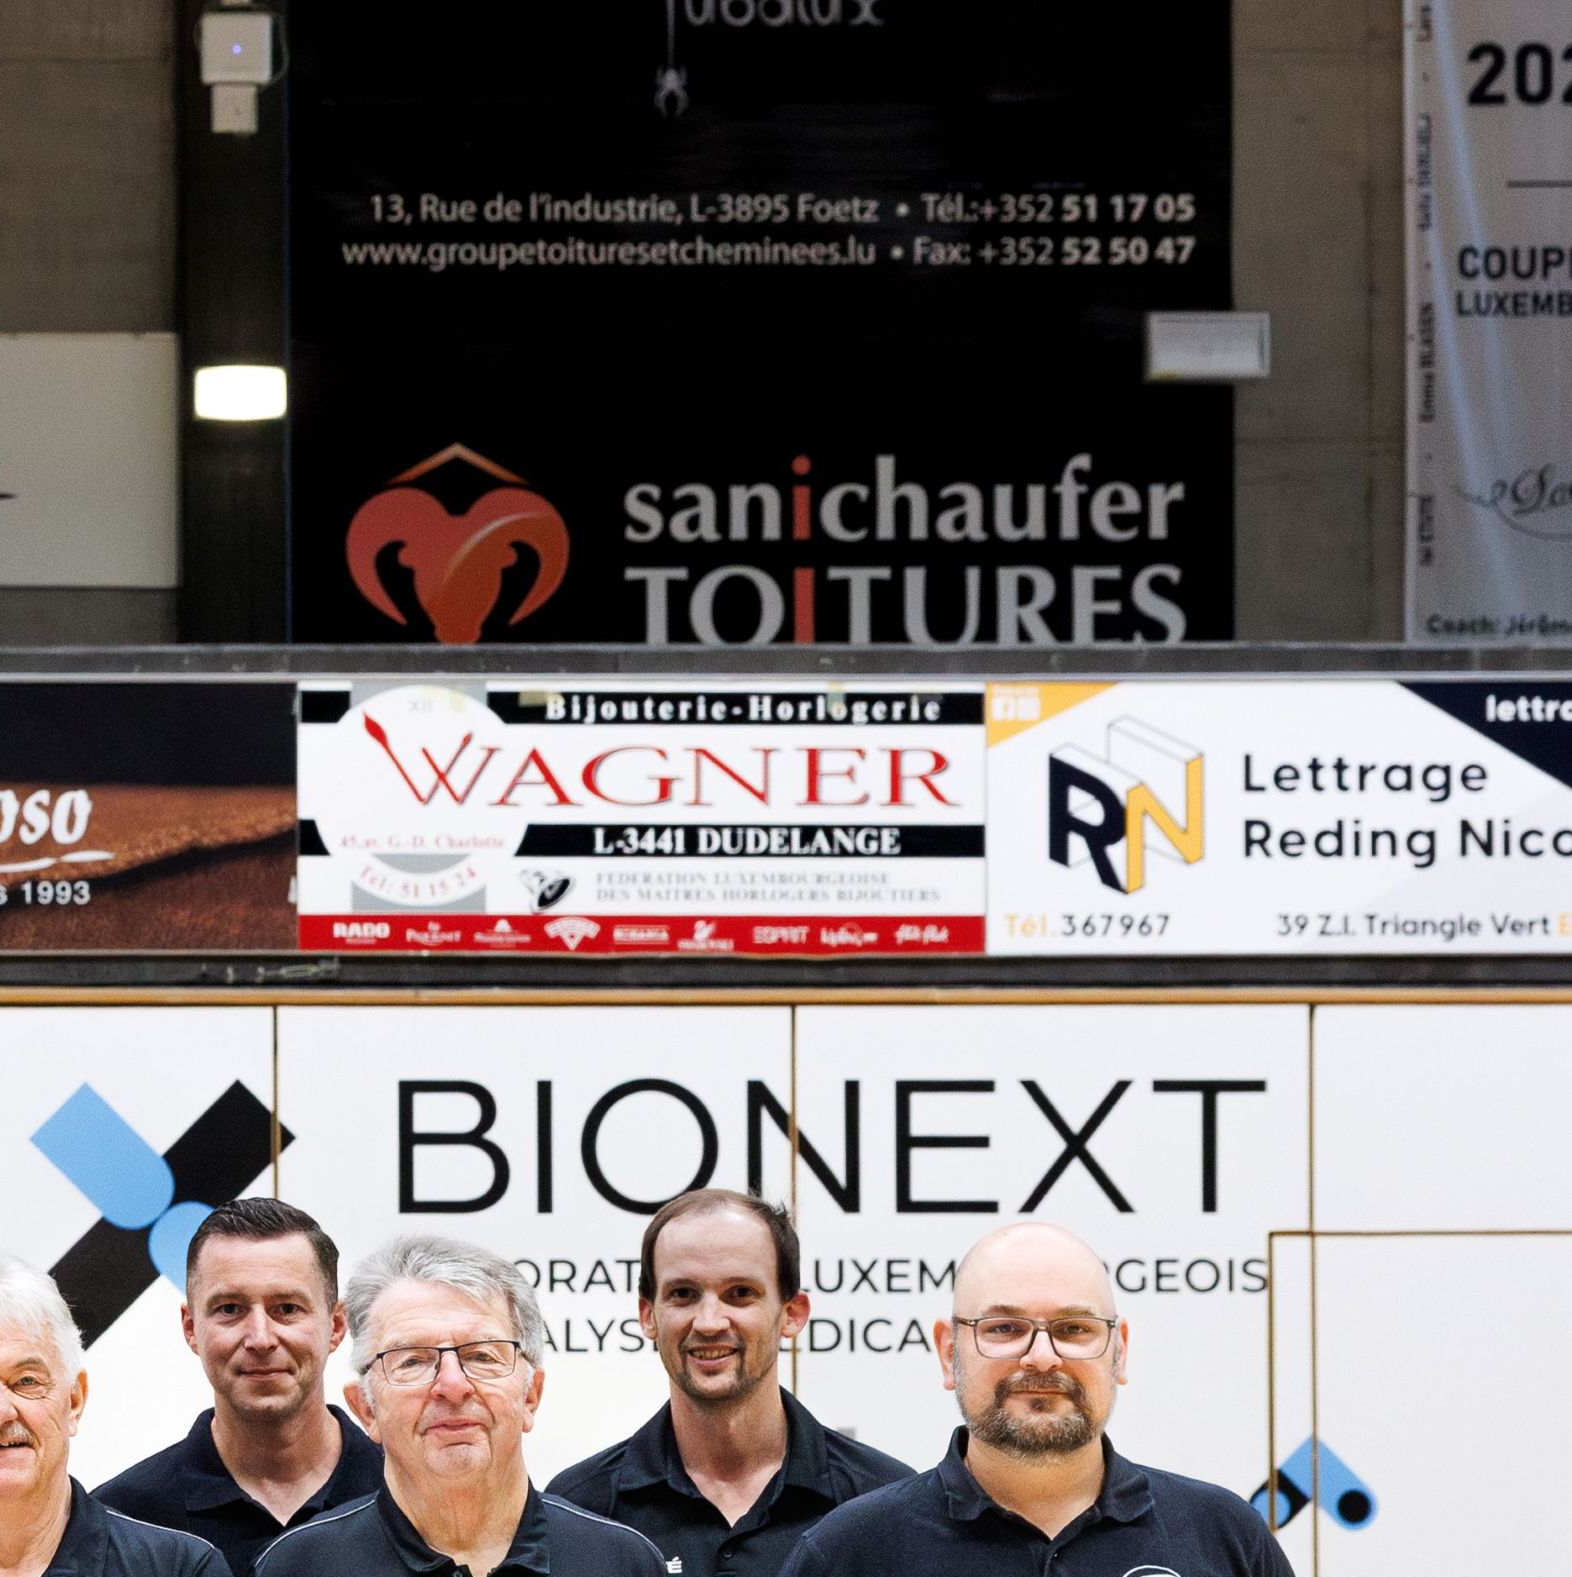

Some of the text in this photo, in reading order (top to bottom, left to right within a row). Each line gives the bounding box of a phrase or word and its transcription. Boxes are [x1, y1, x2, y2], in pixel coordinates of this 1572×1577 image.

[370, 194, 412, 225] 13,
[419, 194, 476, 222] Rue
[484, 193, 522, 222] de
[690, 193, 789, 222] L-3895
[797, 193, 881, 222] Foetz
[1061, 194, 1096, 222] 51
[1110, 194, 1148, 222] 17
[1155, 194, 1195, 222] 05
[341, 234, 1195, 273] www.groupetoituresetcheminees.lu Fax: +352 52 50 47
[1458, 246, 1572, 281] COUP
[624, 453, 1185, 541] sanichaufer
[624, 565, 1187, 644] TOITURES
[546, 693, 942, 725] Bijouterie-Horlogerie
[363, 711, 962, 807] WAGNER
[1244, 753, 1488, 802] Lettrage
[593, 826, 902, 856] L-3441 DUDELANGE
[1244, 819, 1436, 868] Reding
[21, 880, 93, 905] 1993
[1062, 914, 1170, 937] 367967
[1277, 914, 1309, 936] 39
[1365, 912, 1482, 942] Triangle
[1491, 913, 1550, 936] Vert
[398, 1077, 1267, 1215] BIONEXT
